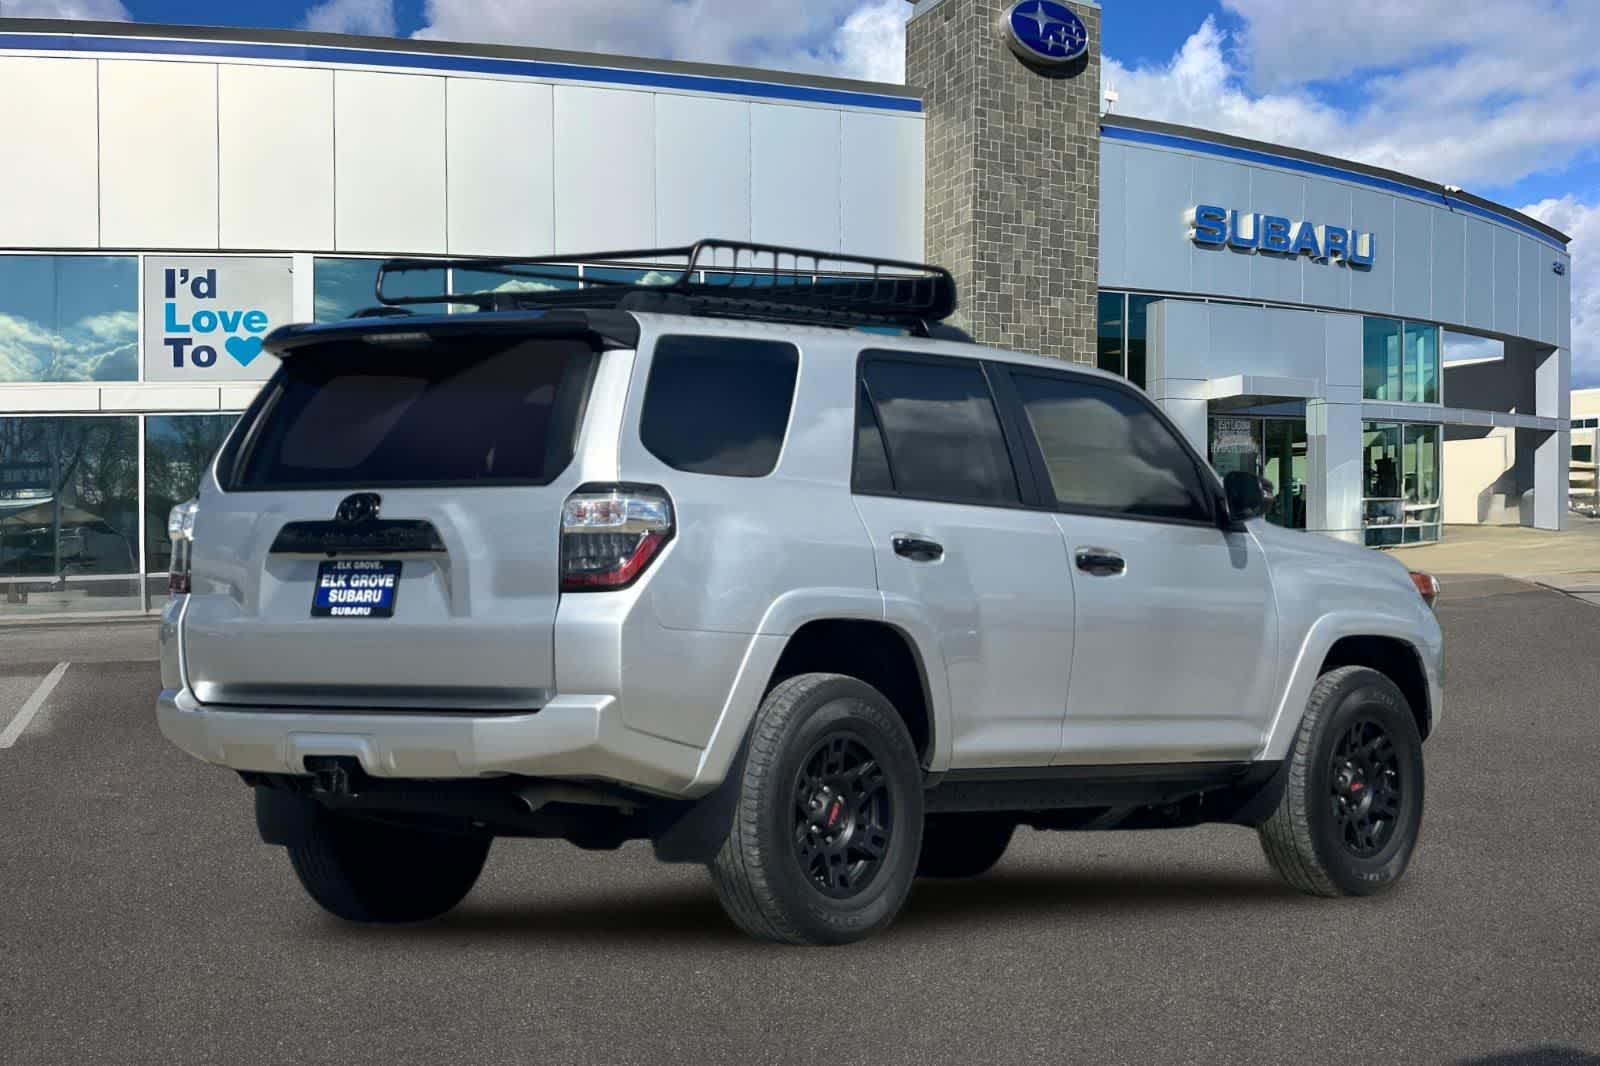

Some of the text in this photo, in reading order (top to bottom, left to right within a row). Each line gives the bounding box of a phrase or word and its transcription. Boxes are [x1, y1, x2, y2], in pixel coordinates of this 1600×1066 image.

[1192, 204, 1376, 267] SUBARU
[165, 268, 217, 299] I'd
[165, 302, 268, 333] Love
[164, 337, 217, 368] To
[337, 561, 352, 569] ELK
[321, 574, 395, 588] ELK GROVE
[328, 589, 383, 603] SUBARU
[330, 606, 372, 615] SUBARU
